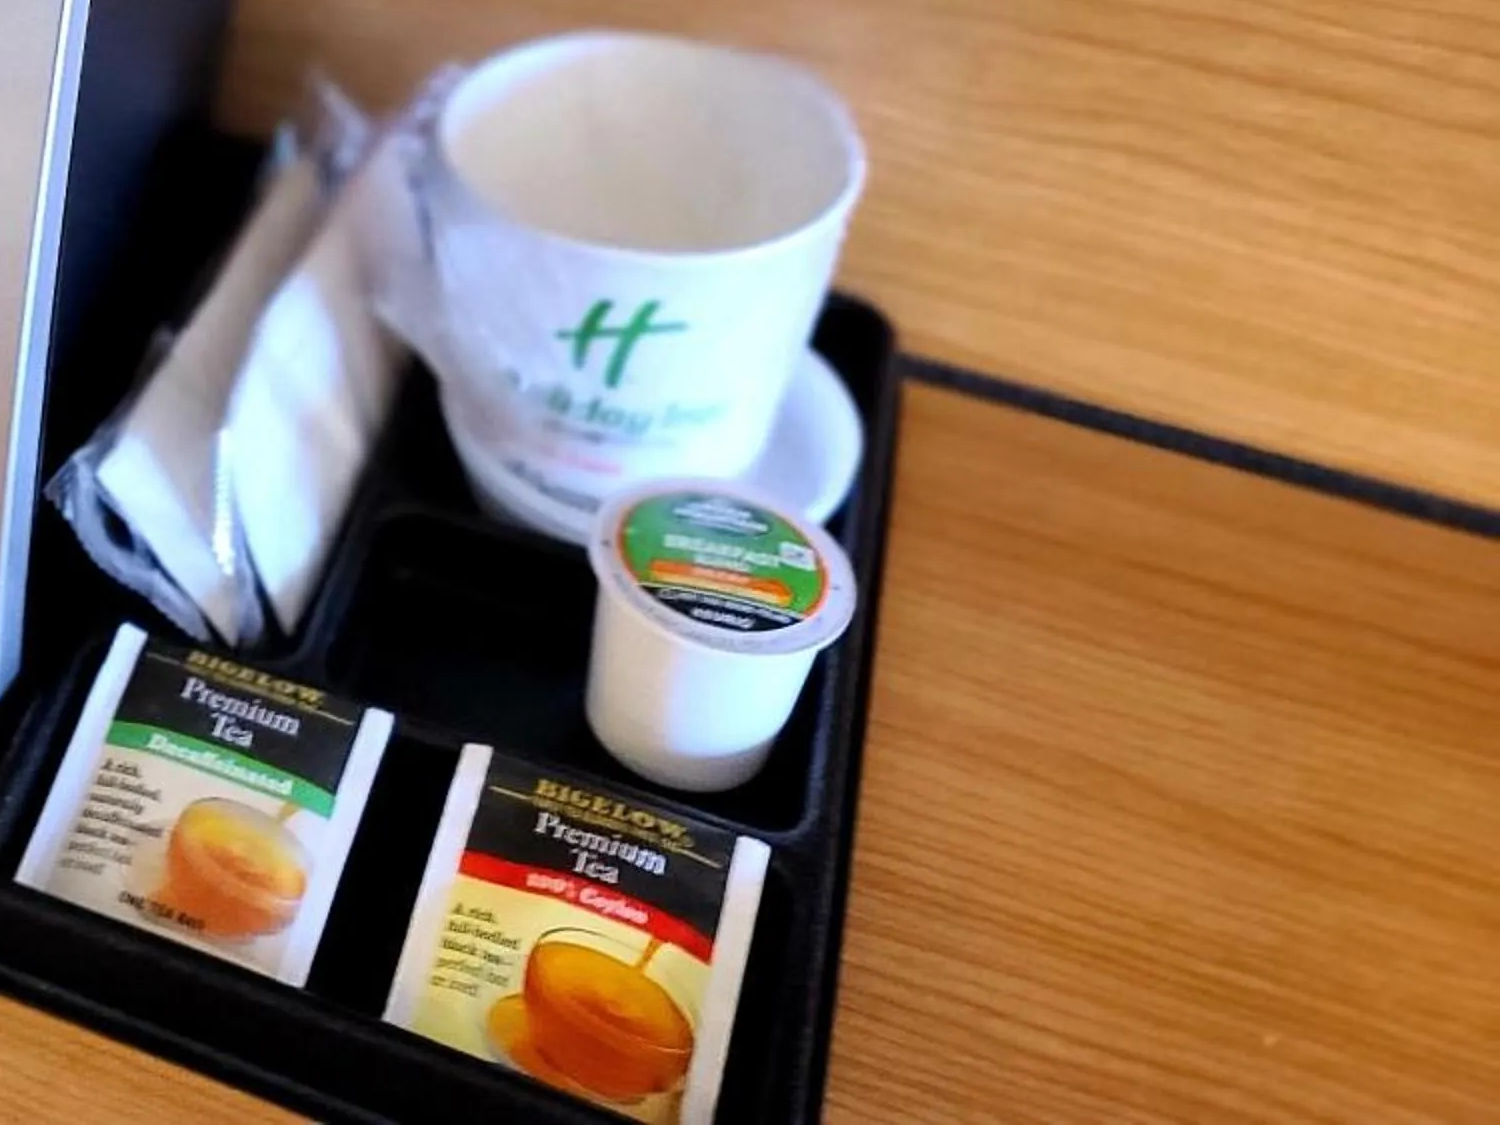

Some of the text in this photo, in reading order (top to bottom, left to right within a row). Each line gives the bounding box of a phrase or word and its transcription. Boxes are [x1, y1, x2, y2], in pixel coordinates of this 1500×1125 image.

[180, 676, 300, 737] Premium
[187, 650, 325, 706] BIGELOW
[210, 712, 254, 747] Tea
[536, 778, 689, 841] BIGELOW
[534, 811, 667, 876] Premium
[570, 847, 620, 884] Tea
